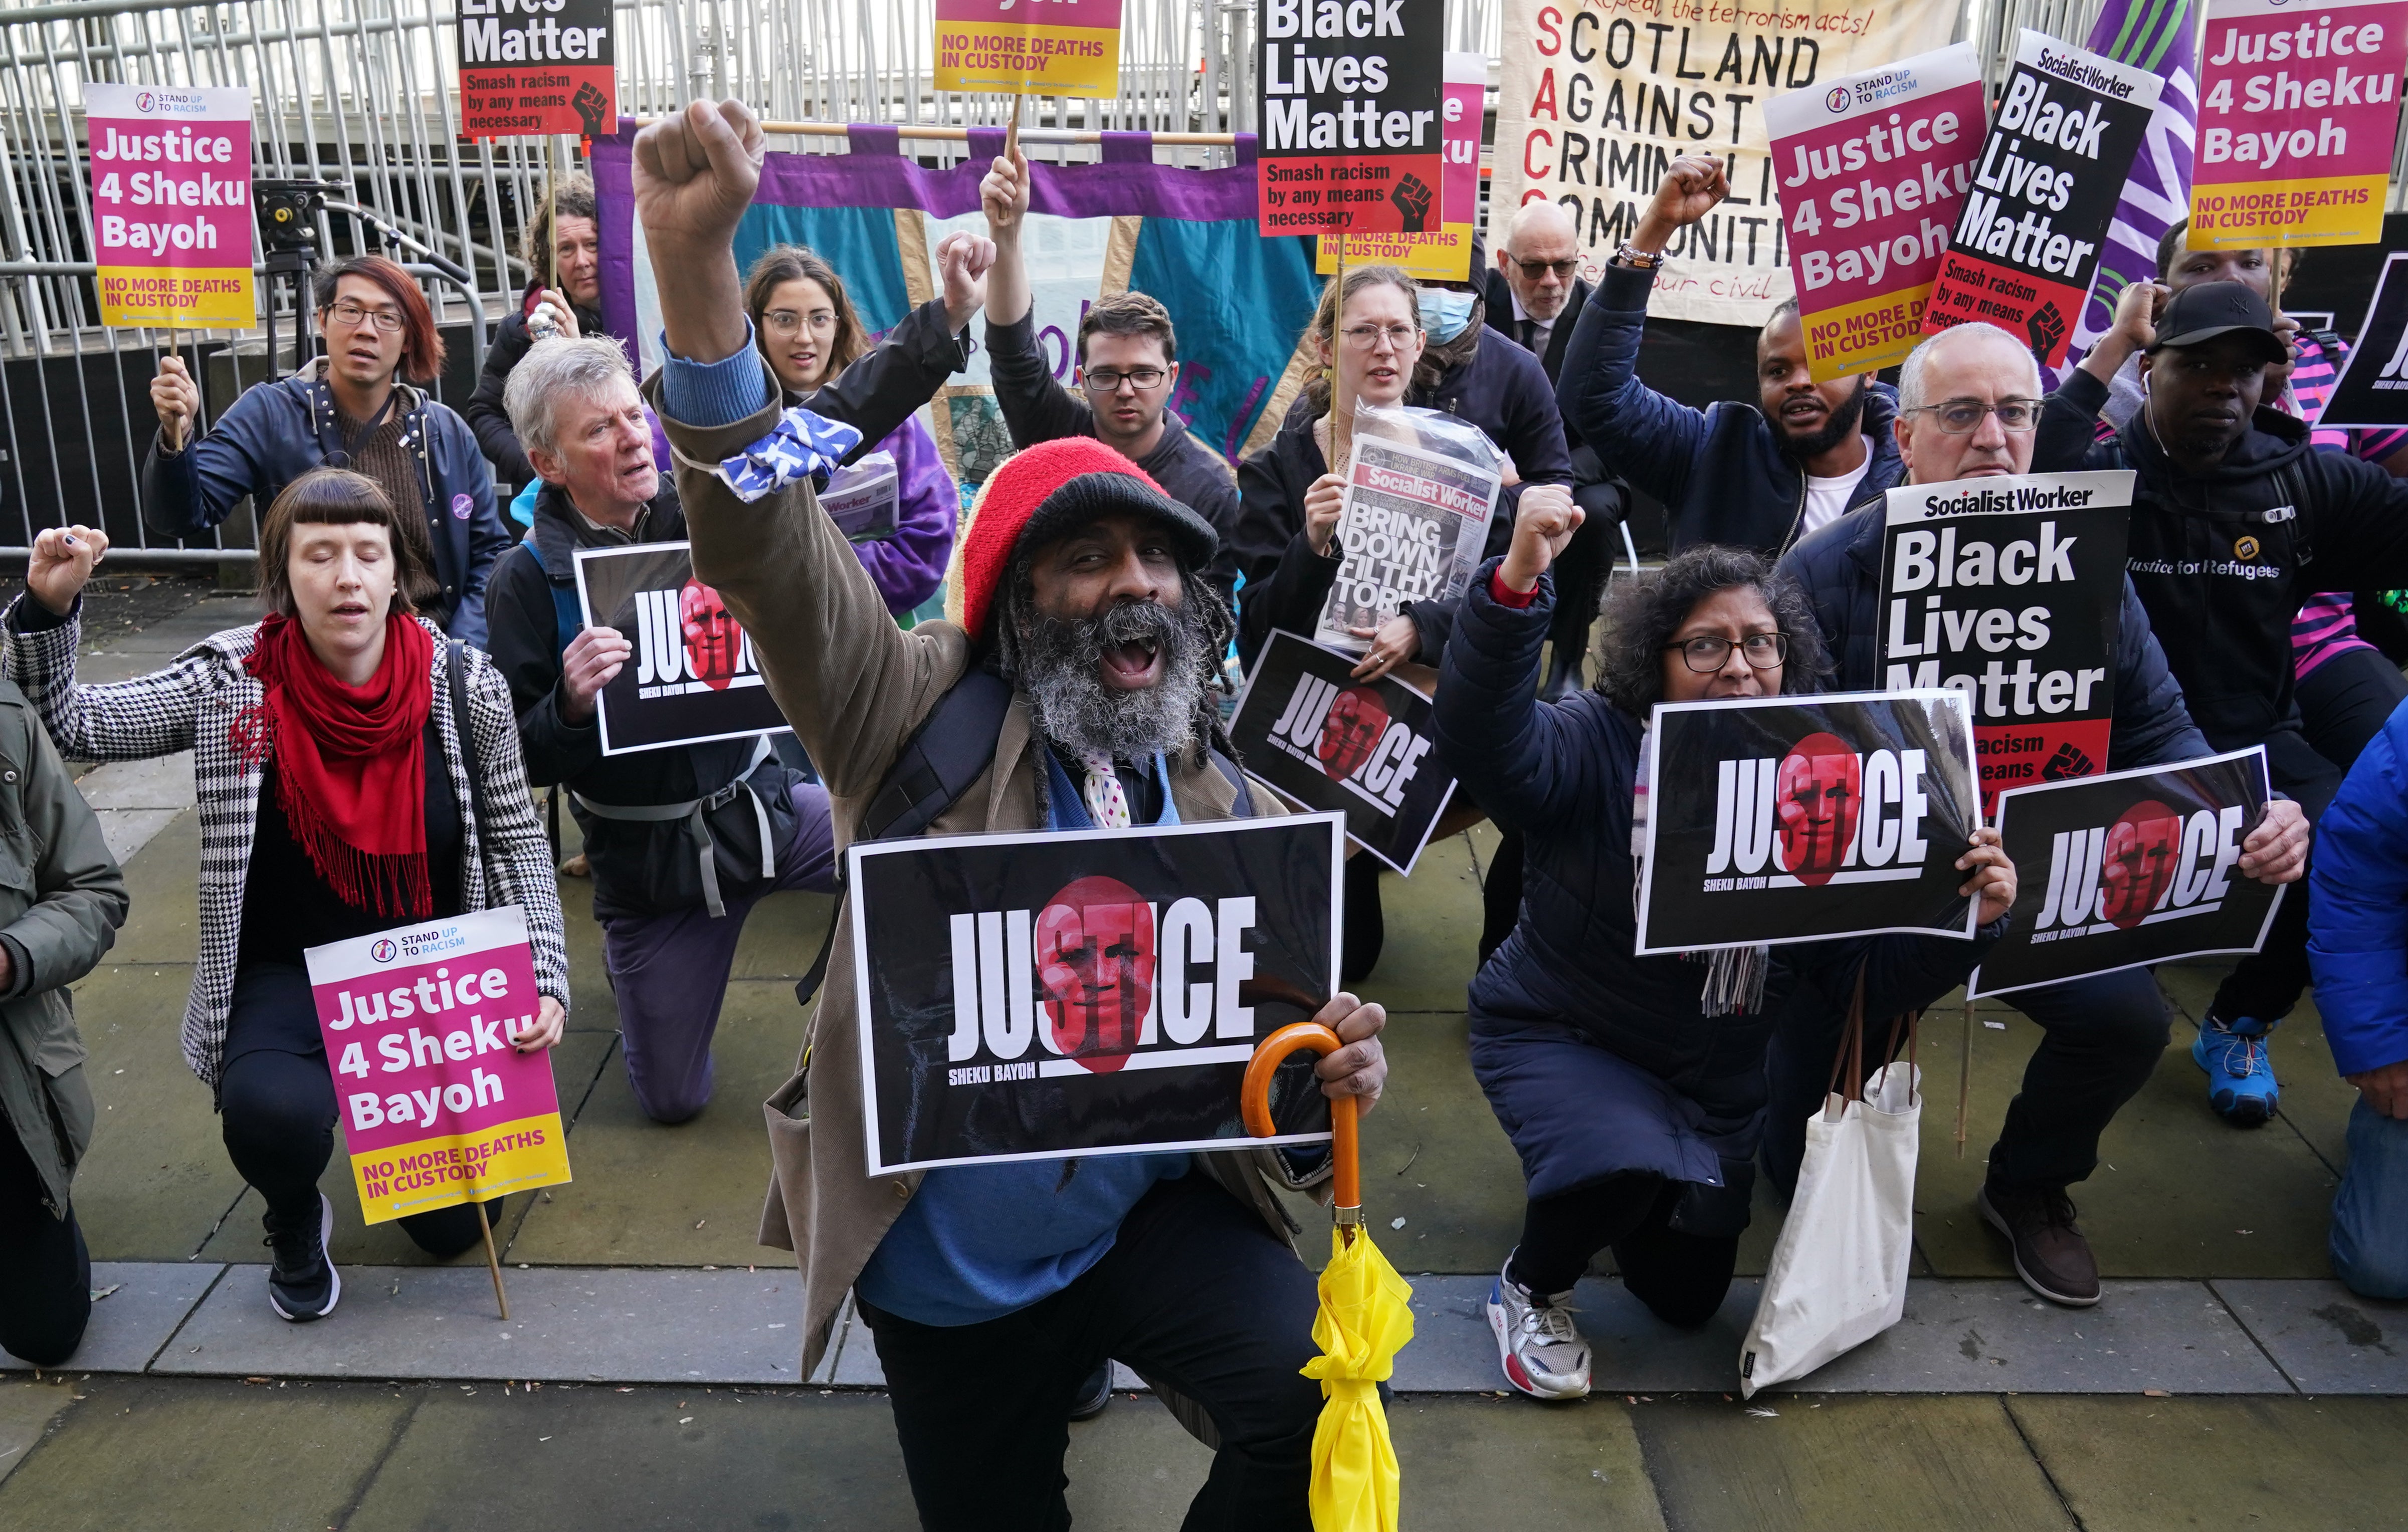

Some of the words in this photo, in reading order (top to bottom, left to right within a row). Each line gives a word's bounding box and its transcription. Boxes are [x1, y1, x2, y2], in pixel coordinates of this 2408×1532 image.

[1266, 0, 1405, 38] Black
[1672, 0, 1703, 21] the
[1710, 3, 1809, 31] terrorism
[1815, 9, 1875, 36] acts!
[463, 18, 607, 62] Matter
[942, 34, 969, 50] NO
[974, 35, 1026, 53] MORE
[1031, 38, 1103, 57] DEATHS
[2210, 16, 2384, 66] Justice
[467, 74, 516, 90] Smash
[521, 72, 570, 88] racism
[941, 52, 959, 68] IN
[965, 52, 1049, 72] CUSTODY
[1266, 43, 1388, 94] Lives
[159, 94, 188, 103] STAND
[1856, 75, 1892, 93] STAND
[1895, 70, 1911, 82] UP
[1857, 93, 1873, 104] TO
[1876, 79, 1918, 100] RACISM
[2205, 79, 2234, 114] 4
[2242, 67, 2395, 113] Sheku
[468, 95, 484, 112] by
[489, 97, 514, 111] any
[519, 95, 566, 108] means
[469, 116, 542, 129] necessary
[1998, 71, 2111, 160] Black
[1266, 98, 1434, 150] Matter
[2203, 117, 2347, 169] Bayoh
[96, 126, 233, 163] Justice
[1784, 111, 1959, 187] Justice
[99, 172, 123, 204] 4
[130, 171, 245, 206] Sheku
[1267, 163, 1324, 182] Smash
[1331, 162, 1390, 180] racism
[1976, 131, 2074, 211] Lives
[1268, 187, 1286, 207] by
[1292, 189, 1321, 206] any
[1327, 188, 1384, 202] means
[1792, 198, 1822, 237] 4
[1830, 159, 1978, 229] Sheku
[2197, 196, 2225, 212] NO
[2230, 192, 2287, 211] MORE
[2291, 188, 2369, 207] DEATHS
[102, 215, 217, 257] Bayoh
[1268, 210, 1353, 227] necessary
[1955, 190, 2094, 278] Matter
[2195, 214, 2214, 229] IN
[2220, 208, 2309, 228] CUSTODY
[1323, 243, 1338, 255] IN
[1344, 243, 1412, 258] CUSTODY
[1397, 233, 1458, 246] DEATHS
[1800, 217, 1949, 291] Bayoh
[104, 278, 127, 291] NO
[132, 279, 177, 292] MORE
[182, 280, 241, 293] DEATHS
[1709, 275, 1772, 300] civil
[1945, 259, 1986, 287] Smash
[1988, 279, 2037, 302] racism
[106, 293, 121, 306] IN
[125, 293, 198, 308] CUSTODY
[1937, 282, 1953, 305] by
[1953, 292, 1976, 312] any
[1977, 299, 2024, 323] means
[1811, 322, 1841, 343] NO
[1846, 304, 1905, 334] MORE
[1814, 341, 1835, 360] IN
[1840, 317, 1924, 353] CUSTOD
[1390, 461, 1419, 476] UKRAINE
[1392, 453, 1408, 465] HOW
[828, 496, 872, 513] Worker
[1368, 468, 1438, 501] Socialist
[1441, 485, 1487, 518] Worker
[1347, 501, 1442, 549] BRING
[1342, 526, 1441, 574] DOWN
[1892, 521, 2078, 593] Black
[2125, 557, 2173, 574] Justice
[2177, 560, 2199, 574] for
[2203, 559, 2280, 580] Refugees
[1337, 550, 1443, 598] FILTHY
[1335, 575, 1439, 615] TORI
[635, 586, 759, 685] JUSTI
[1887, 594, 2052, 659] Lives
[639, 686, 662, 700] SHEKU
[662, 684, 684, 696] BAYOH
[1267, 733, 1287, 751] SHEKU
[1285, 744, 1305, 761] BAYOH
[1271, 671, 1432, 808] JUSTICE
[1975, 734, 2044, 755] acism
[1978, 763, 2034, 780] eans
[1706, 749, 1928, 874] JUSTICE
[1703, 878, 1734, 892] SHEKU
[1736, 876, 1767, 891] BAYOH
[2035, 805, 2243, 930] JUSTICE
[401, 932, 439, 946] STAND
[442, 927, 458, 938] UP
[404, 946, 419, 956] TO
[423, 937, 465, 954] RACISM
[2030, 930, 2058, 944] SHEKU
[2059, 927, 2087, 940] BAYOH
[948, 896, 1256, 1062] JUSTICE
[328, 967, 508, 1031] Justice
[338, 1041, 371, 1079] 4
[377, 1014, 534, 1073] Sheku
[948, 1065, 990, 1086] SHEKU
[994, 1062, 1036, 1083] BAYOH
[348, 1067, 505, 1131] Bayoh
[362, 1161, 394, 1182] NO
[398, 1148, 461, 1175] MORE
[465, 1129, 545, 1163] DEATHS
[366, 1182, 389, 1199] IN
[393, 1160, 488, 1193] CUSTODY
